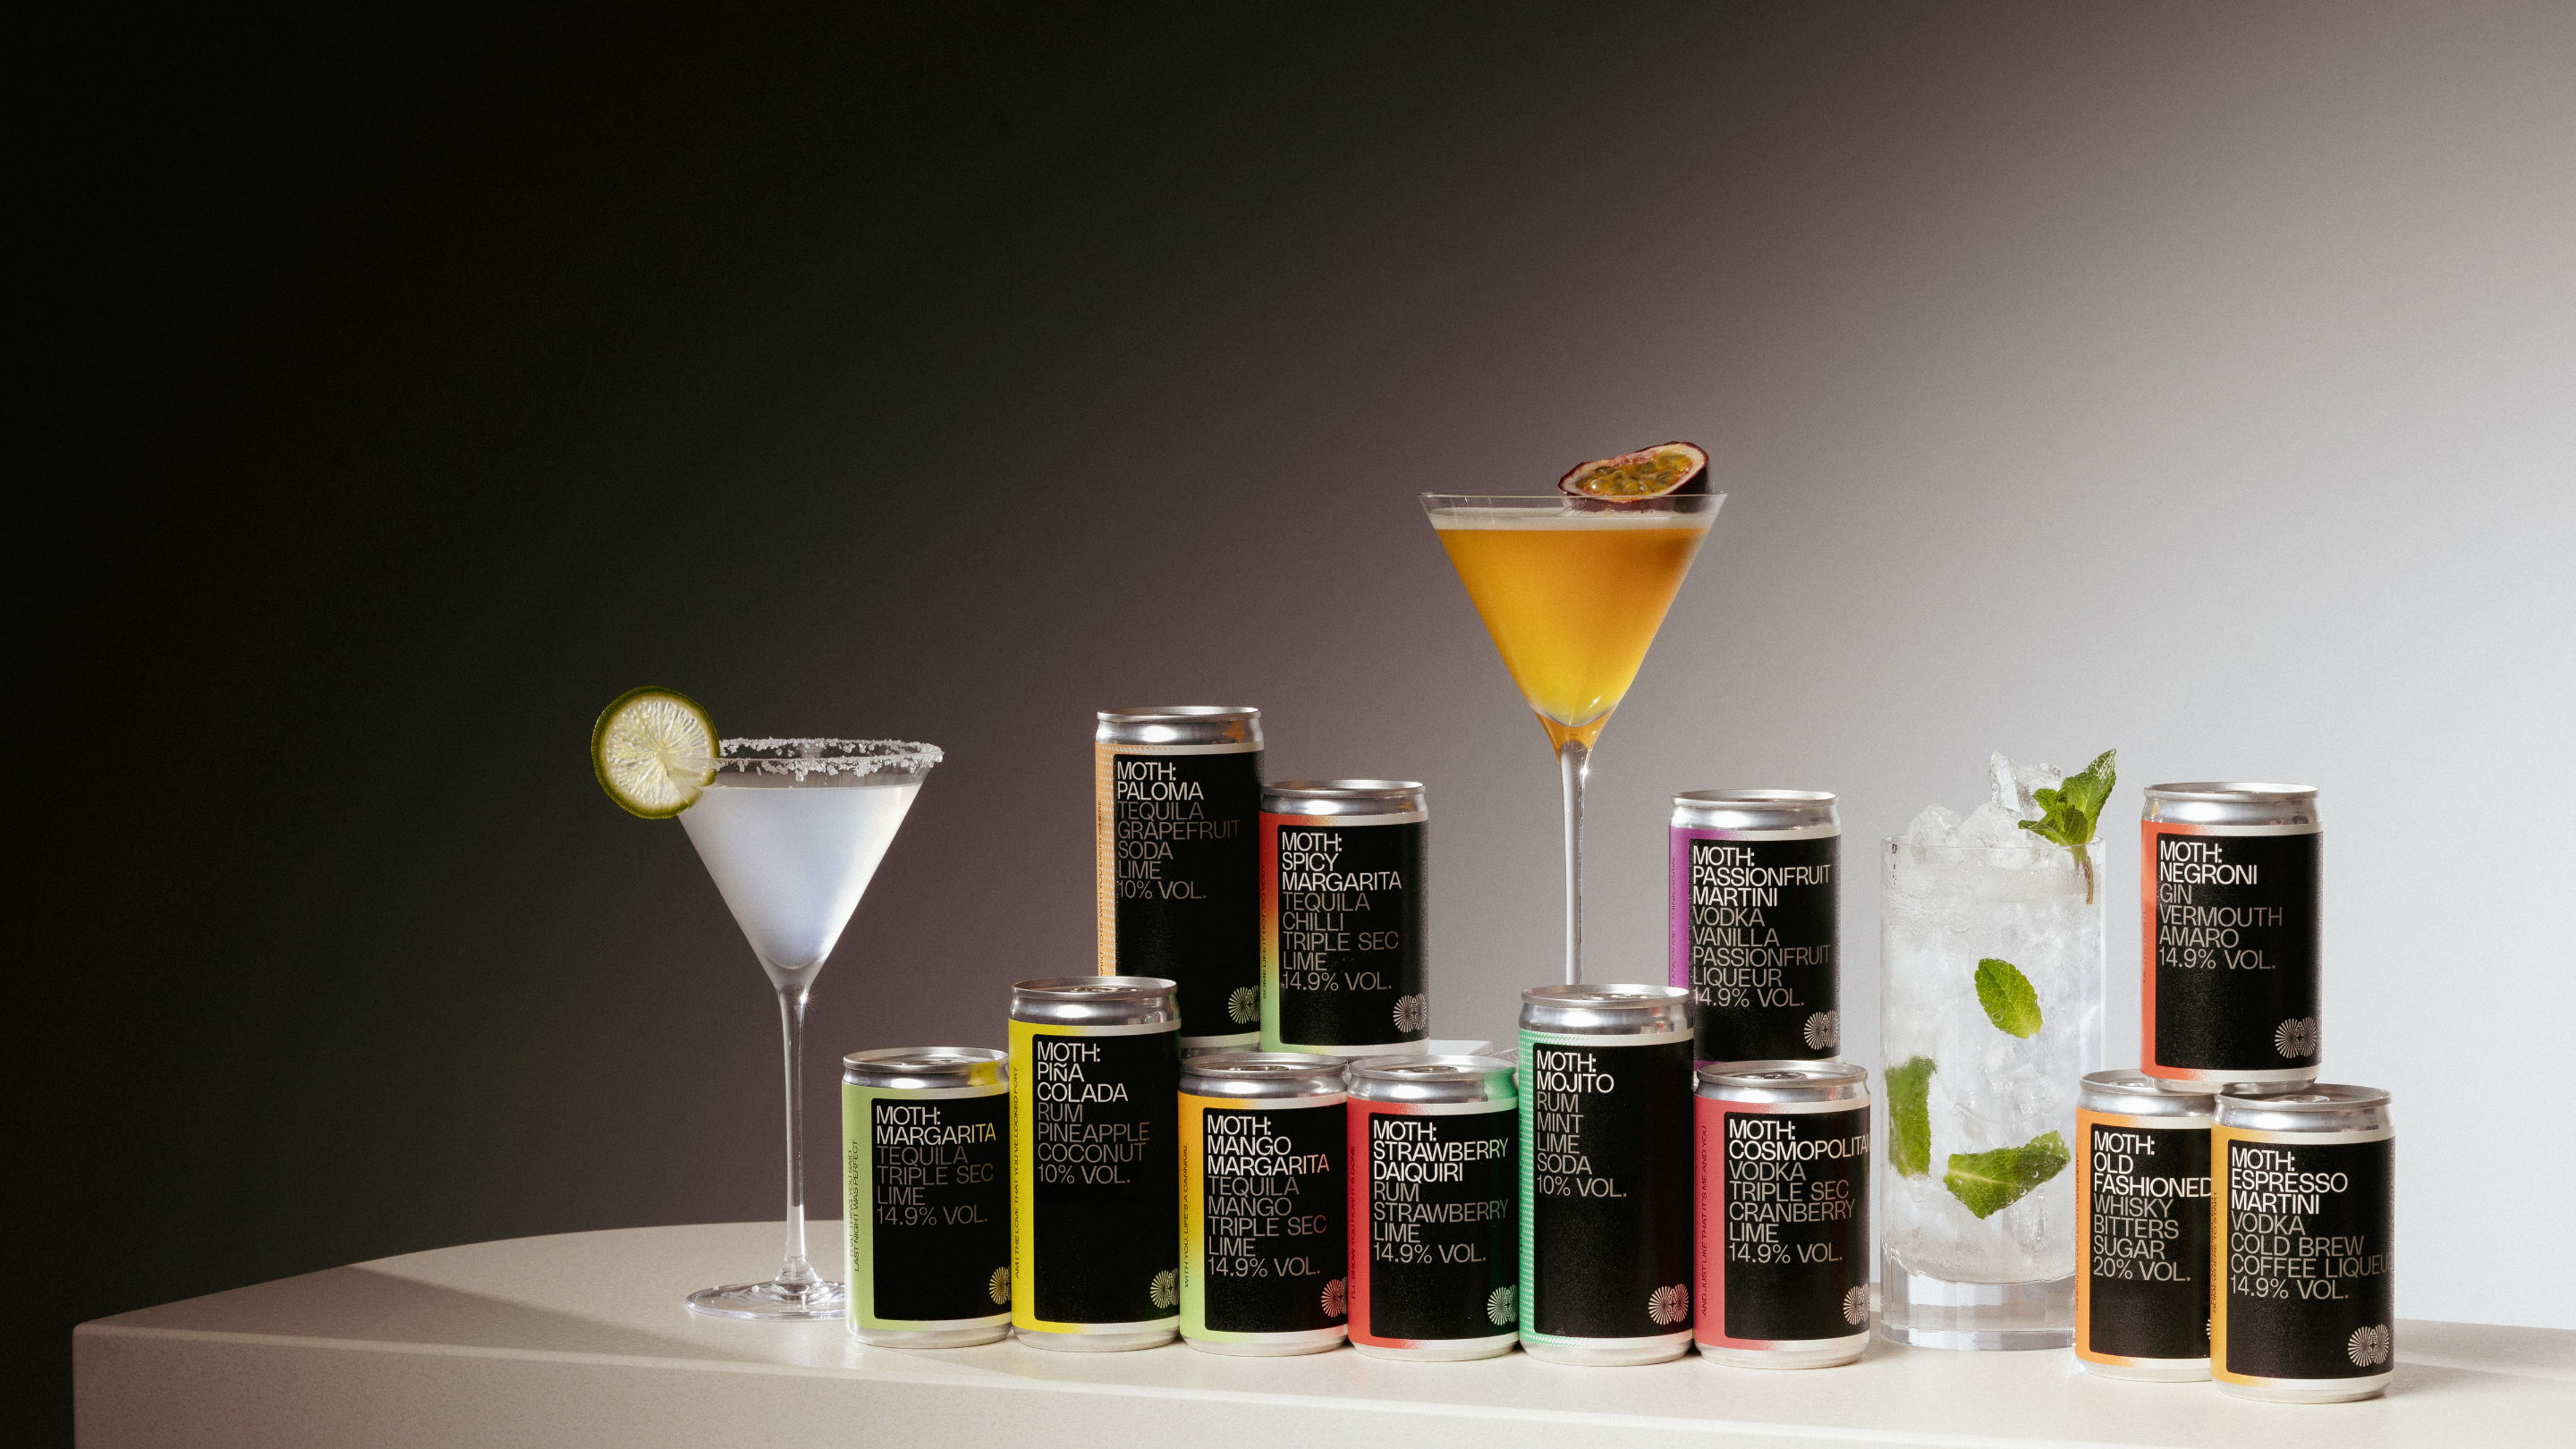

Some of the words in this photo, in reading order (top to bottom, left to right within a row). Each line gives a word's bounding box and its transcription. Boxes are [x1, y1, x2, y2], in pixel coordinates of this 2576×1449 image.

[1118, 761, 1176, 781] MOTH:
[1117, 781, 1204, 801] PALOMA
[1118, 801, 1203, 821] TEQUILA
[1118, 819, 1241, 840] GRAPEFRUIT
[1118, 840, 1173, 860] SODA
[1283, 832, 1342, 852] MOTH:
[2161, 841, 2222, 863] MOTH:
[1283, 852, 1338, 871] SPICY
[1693, 845, 1754, 866] MOTH:
[1118, 861, 1161, 878] LIME
[1693, 864, 1831, 886] PASSIONFRUIT
[2161, 861, 2257, 885] NEGRONI
[1119, 881, 1152, 899] 10%
[1158, 881, 1206, 899] VOL.
[1283, 871, 1402, 891] MARGARITA
[1283, 892, 1370, 912] TEQUILA
[1693, 886, 1777, 906] MARTINI
[2161, 883, 2191, 906] GIN
[1284, 911, 1343, 931] CHILLI
[1693, 905, 1765, 927] VODKA
[2160, 905, 2282, 928] VERMOUTH
[1283, 931, 1350, 951] TRIPLE
[1359, 931, 1398, 951] SEC
[1693, 925, 1779, 947] VANILLA
[2159, 926, 2239, 948] AMARO
[1284, 952, 1327, 970] LIME
[1693, 945, 1830, 967] PASSIONFRUIT
[2159, 946, 2216, 969] 14.9%
[2224, 950, 2275, 970] VOL.
[1283, 971, 1338, 991] 14.9%
[1344, 971, 1392, 990] VOL.
[1693, 968, 1782, 987] LIQUEUR
[1694, 985, 1749, 1007] 14.9%
[1758, 988, 1804, 1007] VOL.
[1038, 1041, 1100, 1062] MOTH:
[1538, 1050, 1596, 1072] MOTH:
[1038, 1062, 1084, 1081] PIÑA
[1538, 1071, 1614, 1093] MOJITO
[1038, 1082, 1128, 1102] COLADA
[1538, 1091, 1578, 1113] RUM
[877, 1106, 940, 1125] MOTH:
[1038, 1102, 1082, 1122] RUM
[1538, 1112, 1584, 1133] MINT
[877, 1123, 996, 1145] MARGARITA
[1038, 1122, 1149, 1142] PINEAPPLE
[1208, 1114, 1271, 1135] MOTH:
[1374, 1120, 1436, 1141] MOTH:
[1730, 1119, 1795, 1140] MOTH:
[1038, 1142, 1146, 1163] COCONUT
[1208, 1135, 1291, 1156] MANGO
[1374, 1138, 1508, 1161] STRAWBERRY
[1538, 1132, 1580, 1154] LIME
[1729, 1133, 1870, 1160] COSMOPOLITA
[2095, 1131, 2155, 1155] MOTH:
[877, 1146, 968, 1166] TEQUILA
[1208, 1154, 1329, 1175] MARGARITA
[1538, 1153, 1592, 1174] SODA
[2094, 1152, 2133, 1174] OLD
[2233, 1147, 2295, 1171] MOTH:
[877, 1165, 948, 1185] TRIPLE
[957, 1164, 993, 1183] SEC
[1038, 1164, 1074, 1183] 10%
[1081, 1165, 1130, 1183] VOL.
[1374, 1160, 1462, 1183] DAIQUIRI
[1729, 1160, 1806, 1181] VODKA
[2232, 1168, 2348, 1193] ESPRESSO
[1208, 1175, 1299, 1198] TEQUILA
[1375, 1182, 1421, 1202] RUM
[1538, 1174, 1571, 1196] 10%
[1576, 1178, 1626, 1197] VOL.
[1702, 1174, 1707, 1191] ME
[1730, 1181, 1802, 1201] TRIPLE
[1811, 1180, 1849, 1200] SEC
[2094, 1174, 2211, 1198] FASHIONED
[878, 1186, 925, 1205] LIME
[1208, 1196, 1292, 1216] MANGO
[2094, 1193, 2174, 1217] WHISKY
[2232, 1189, 2318, 1214] MARTINI
[877, 1206, 936, 1225] 14.9%
[944, 1205, 987, 1224] VOL.
[1374, 1200, 1509, 1223] STRAWBERRY
[1730, 1199, 1854, 1222] CRANBERRY
[1208, 1216, 1279, 1236] TRIPLE
[1288, 1215, 1326, 1235] SEC
[1375, 1222, 1420, 1242] LIME
[1730, 1222, 1778, 1242] LIME
[2095, 1214, 2179, 1239] BITTERS
[2232, 1210, 2305, 1235] VODKA
[1209, 1236, 1256, 1257] LIME
[1374, 1242, 1432, 1263] 14.9%
[1438, 1243, 1486, 1263] VOL.
[1729, 1242, 1790, 1263] 14.9%
[1797, 1242, 1842, 1263] VOL.
[2094, 1235, 2165, 1259] SUGAR
[2232, 1233, 2290, 1256] COLD
[2299, 1236, 2363, 1257] BREW
[1208, 1257, 1267, 1276] 14.9%
[1274, 1257, 1320, 1276] VOL.
[2094, 1256, 2132, 1279] 20%
[2139, 1261, 2190, 1281] VOL.
[2232, 1253, 2316, 1277] COFFEE
[2231, 1275, 2288, 1299] 14.9%
[2297, 1280, 2348, 1299] VOL.
